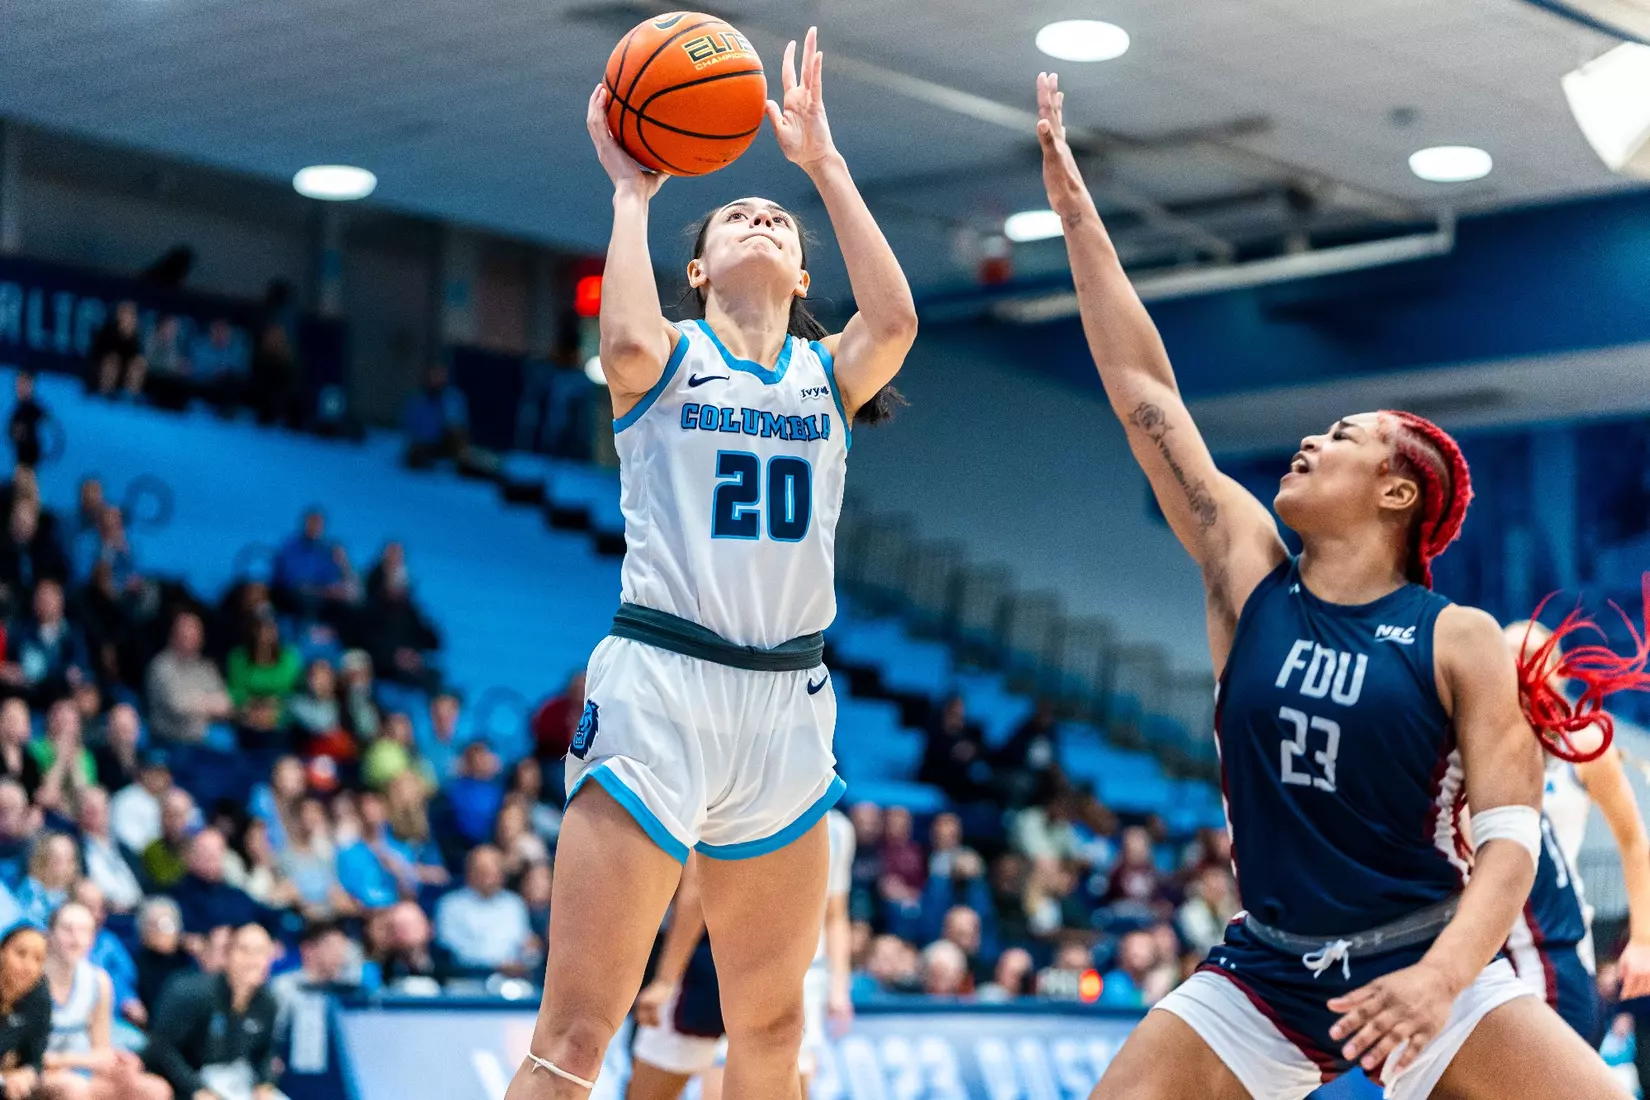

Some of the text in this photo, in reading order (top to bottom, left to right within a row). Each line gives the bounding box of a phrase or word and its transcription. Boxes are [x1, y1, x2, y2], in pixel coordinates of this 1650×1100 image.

[681, 402, 831, 442] COLUMBIA
[801, 387, 820, 398] Ivy
[711, 450, 812, 542] 20
[1275, 638, 1369, 707] FDU
[1279, 706, 1341, 792] 23
